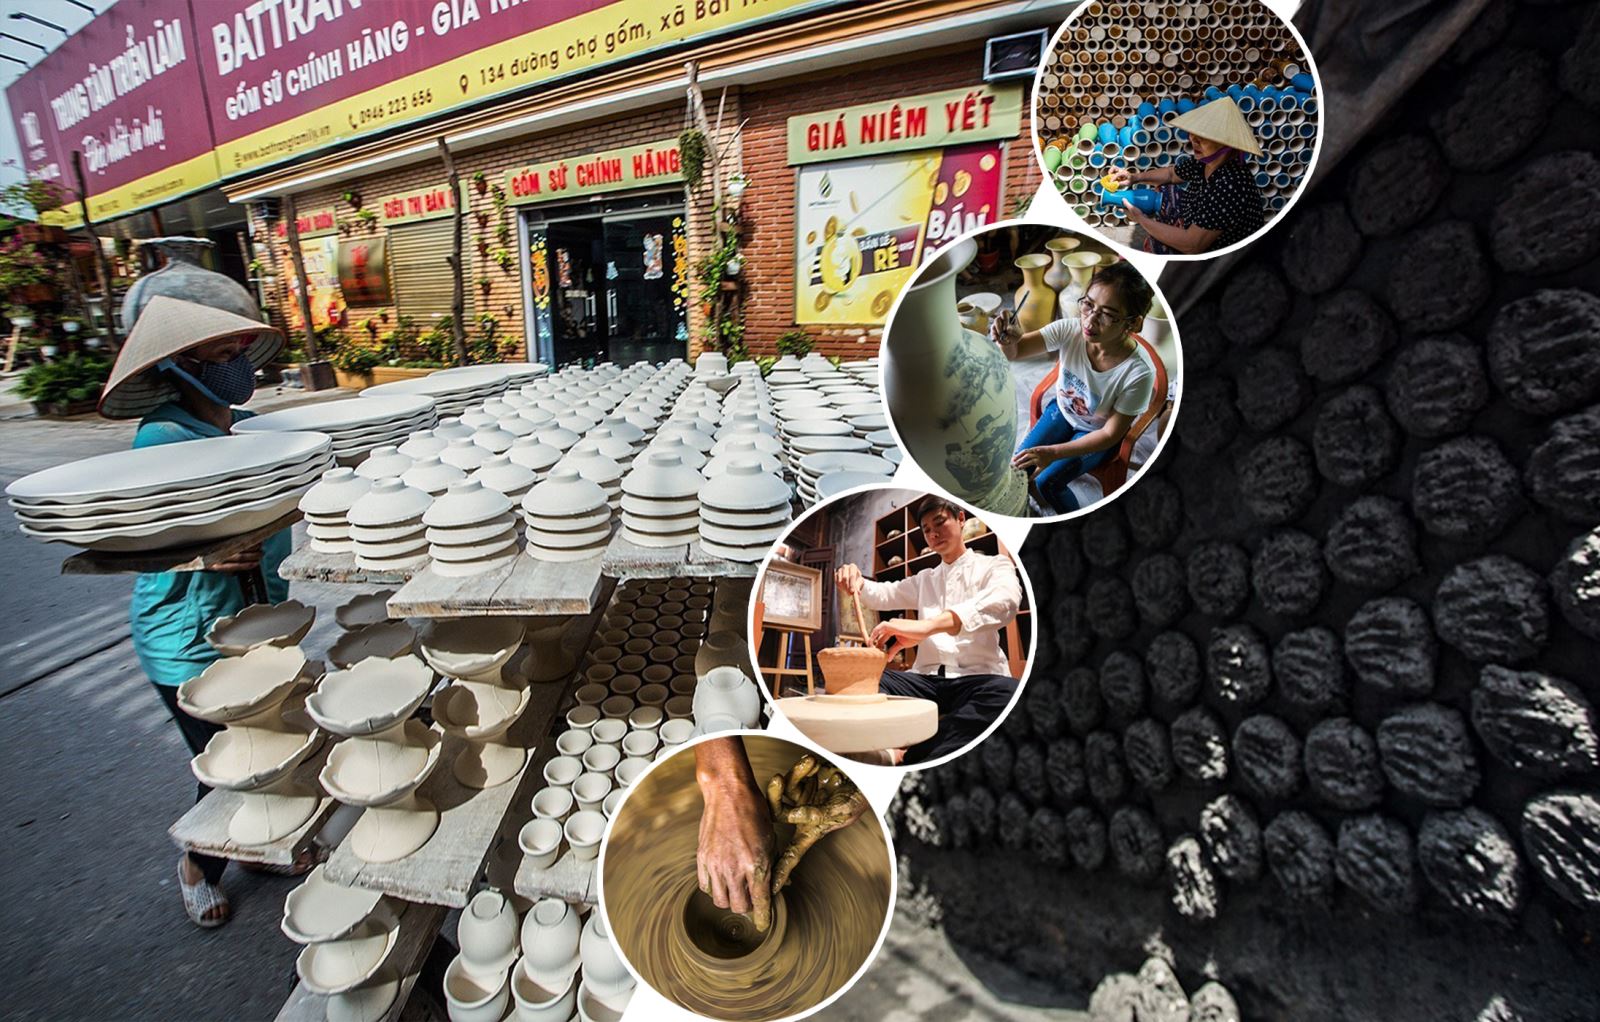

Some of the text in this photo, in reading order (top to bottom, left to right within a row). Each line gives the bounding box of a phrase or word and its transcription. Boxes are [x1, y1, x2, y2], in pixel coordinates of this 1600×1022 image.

[212, 0, 362, 76] BATTRA
[225, 81, 261, 120] GỐM
[262, 69, 283, 106] SỨ
[286, 52, 344, 96] CHÍNH
[346, 20, 409, 72] HÃNG
[360, 104, 384, 124] 0946
[388, 96, 408, 115] 223
[480, 63, 505, 85] 134
[510, 51, 560, 70] đường
[565, 34, 598, 59] chợ
[604, 18, 652, 53] gốm,
[660, 5, 685, 31] xã
[807, 90, 996, 151] GIÁ NIÊM YẾT
[511, 148, 682, 197] GỐM SỨ CHÍNH HÃNG
[926, 203, 987, 241] BÁN
